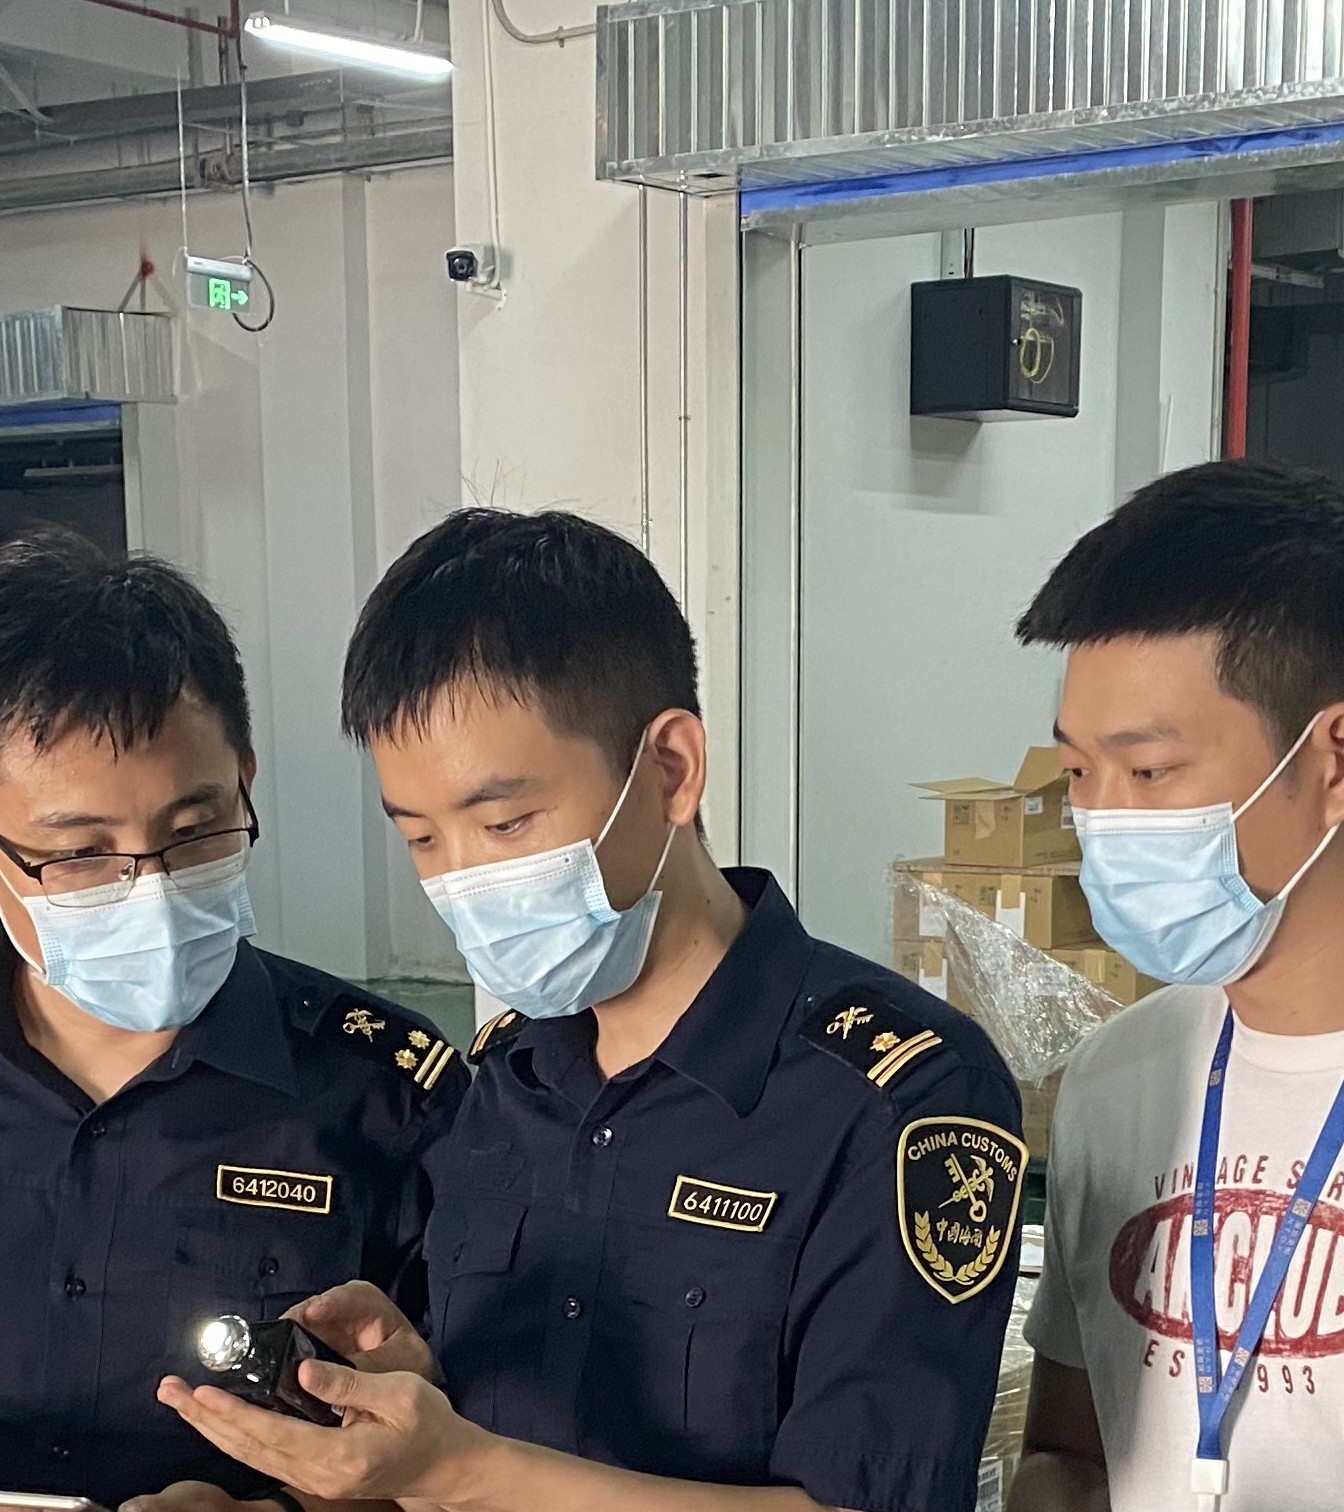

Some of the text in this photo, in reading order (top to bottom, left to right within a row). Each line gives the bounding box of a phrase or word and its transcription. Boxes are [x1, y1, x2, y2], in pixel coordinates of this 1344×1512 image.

[908, 1131, 1018, 1182] CHINA CUSTOMS
[232, 1175, 316, 1204] 6412040
[1154, 1155, 1267, 1200] VINAGE
[683, 1192, 763, 1222] 6411100
[1235, 1363, 1316, 1395] 993
